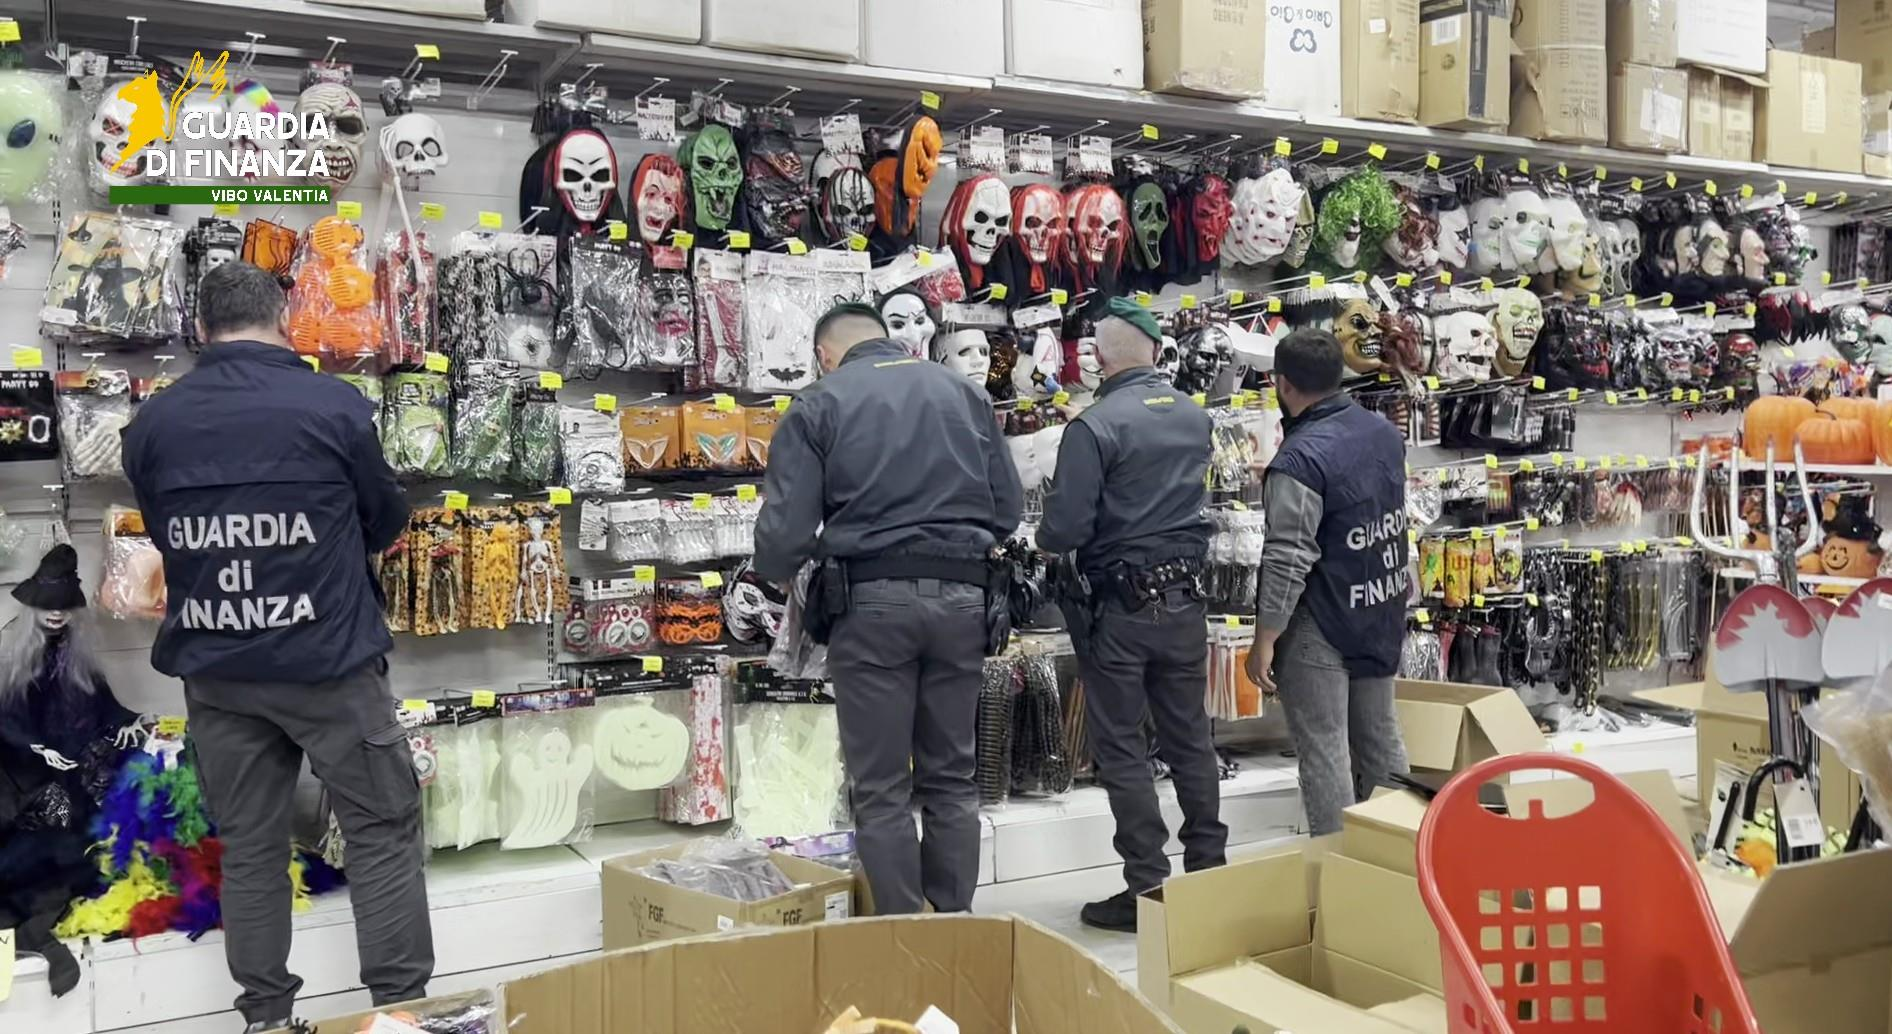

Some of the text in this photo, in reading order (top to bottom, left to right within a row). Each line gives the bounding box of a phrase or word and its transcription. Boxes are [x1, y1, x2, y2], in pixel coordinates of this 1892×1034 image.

[168, 512, 316, 550] GUARDIA
[1347, 507, 1408, 550] GUARDI
[1382, 542, 1399, 569] di
[218, 559, 254, 592] di
[1350, 567, 1408, 608] FINANZ
[181, 593, 317, 631] INANZA
[648, 903, 664, 924] FGF
